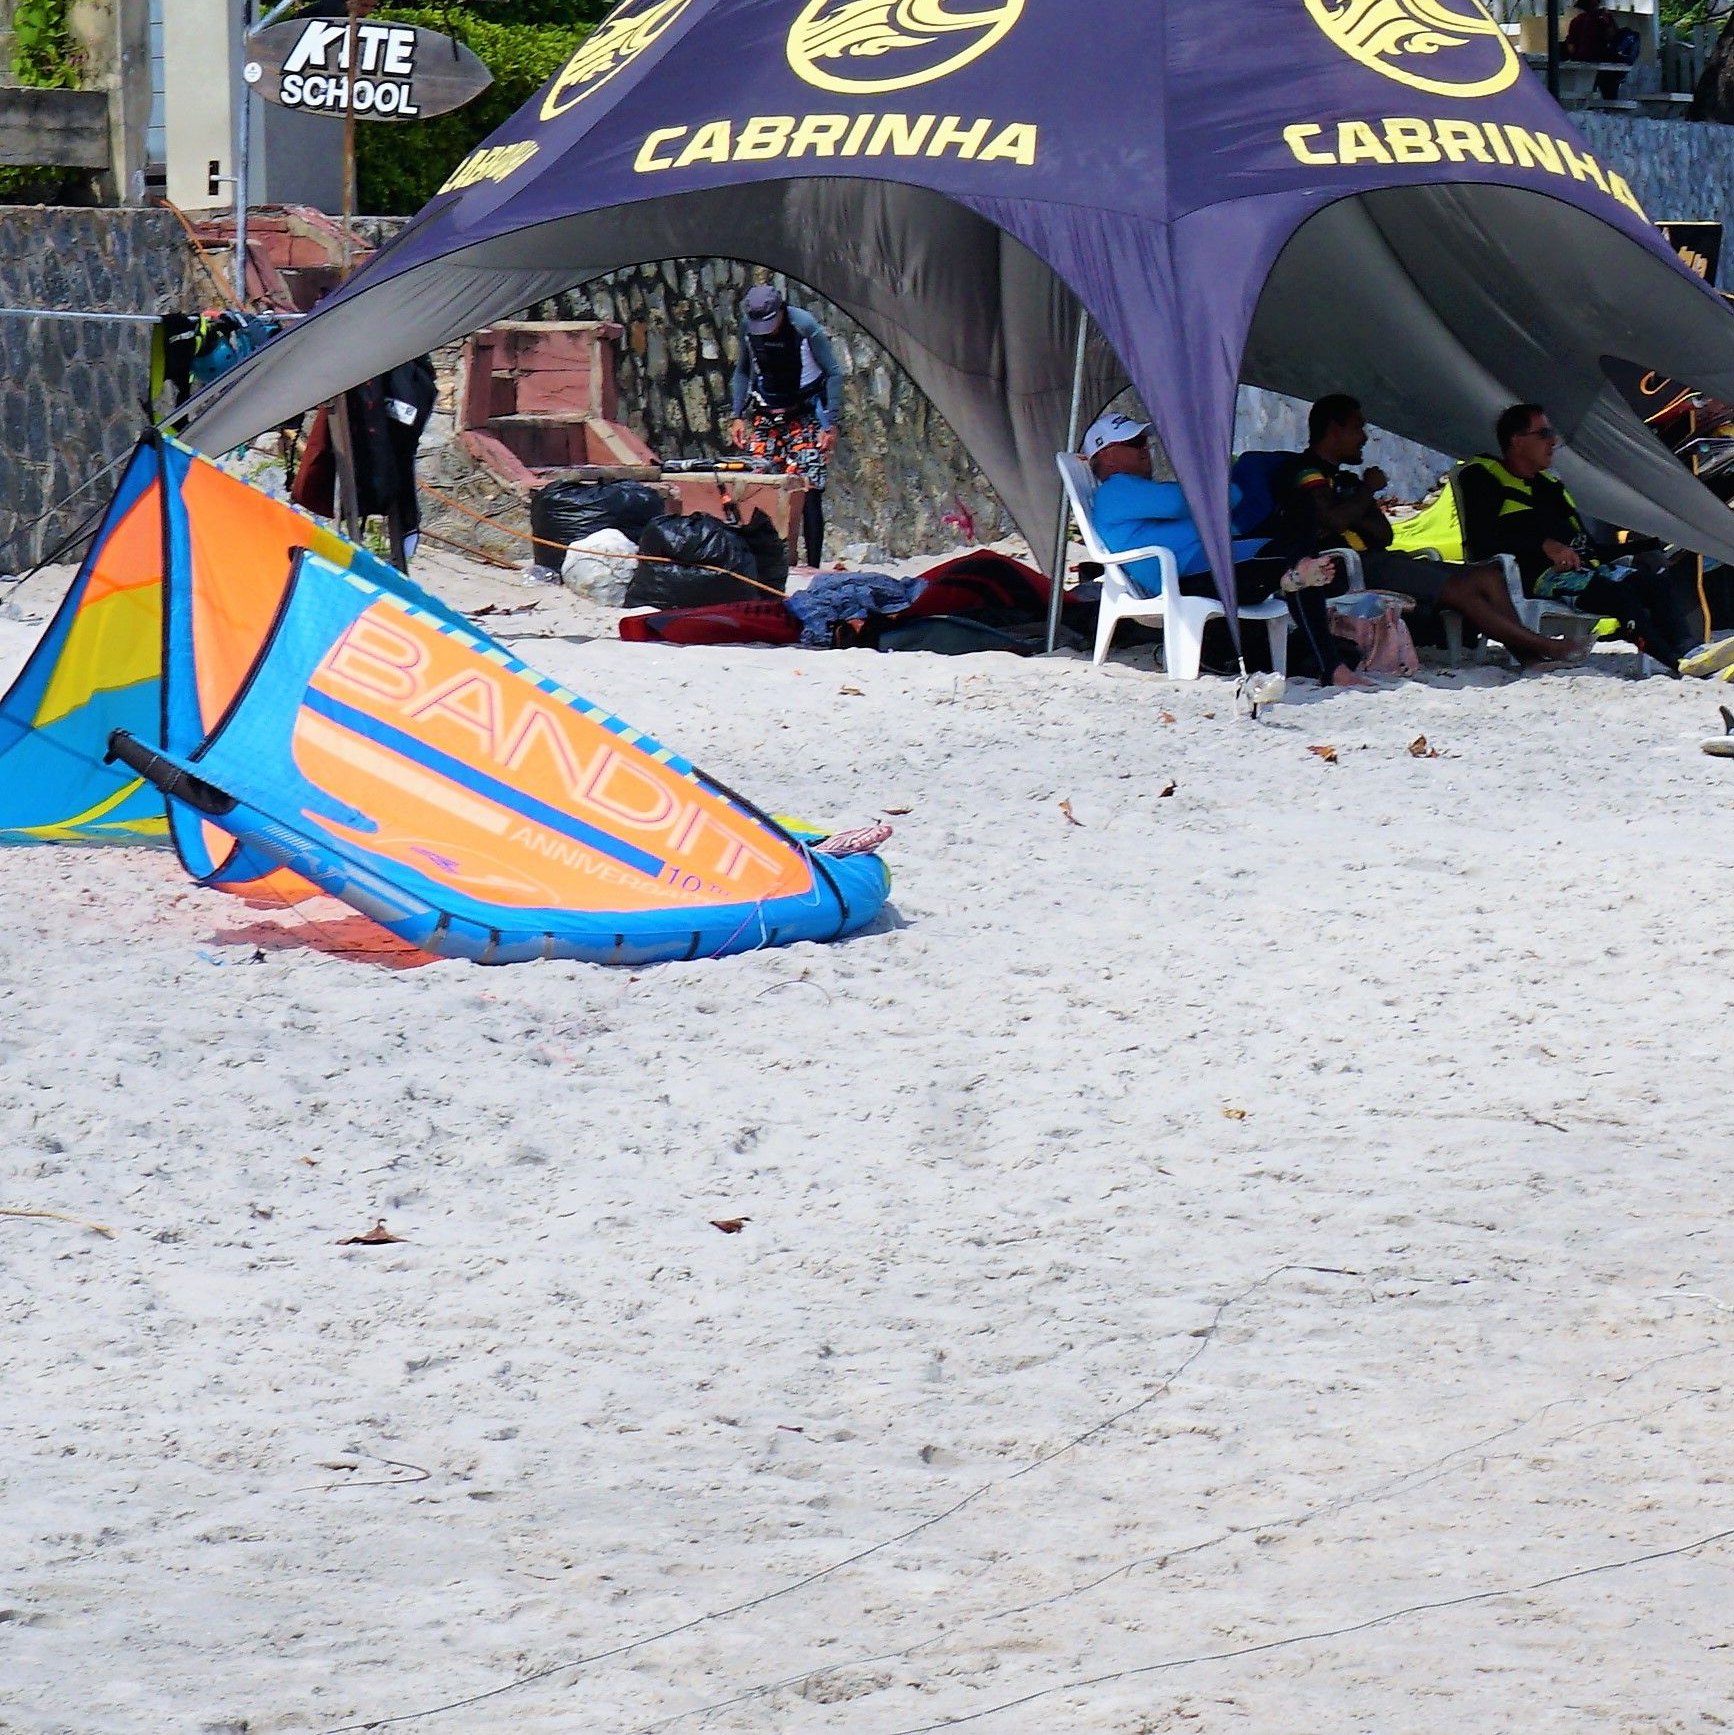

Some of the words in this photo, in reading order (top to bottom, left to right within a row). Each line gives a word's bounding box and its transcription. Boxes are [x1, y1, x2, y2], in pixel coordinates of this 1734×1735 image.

[283, 20, 416, 75] KITE
[280, 73, 420, 116] SCHOOL
[633, 113, 1040, 172] CABRINHA
[1283, 116, 1652, 226] CABRINHA
[321, 610, 786, 882] BANDIT
[666, 866, 702, 894] 10
